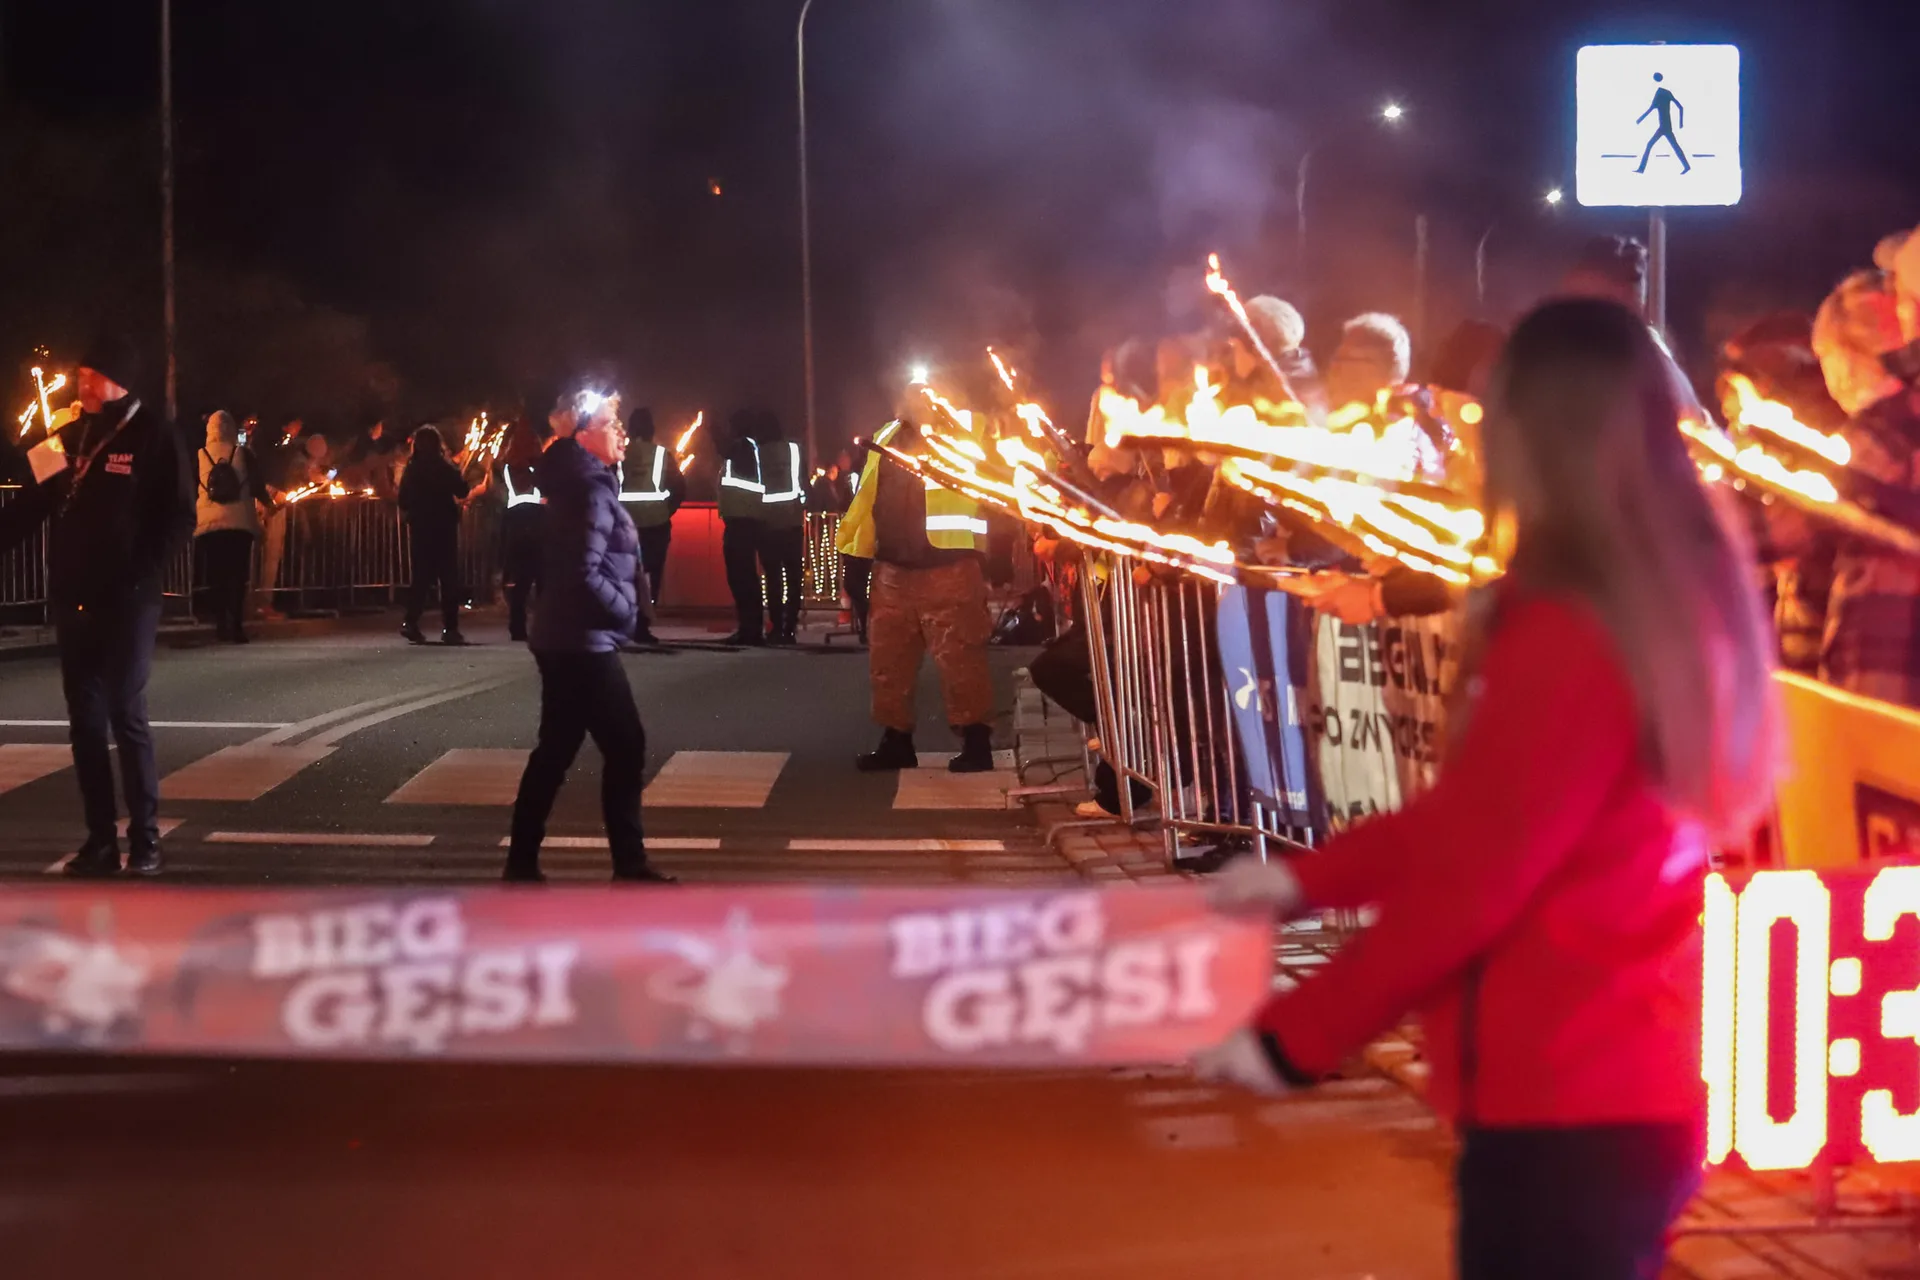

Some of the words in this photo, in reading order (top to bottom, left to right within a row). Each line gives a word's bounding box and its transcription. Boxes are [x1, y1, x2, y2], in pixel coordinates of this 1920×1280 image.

[253, 897, 463, 977] BIEG
[891, 895, 1104, 977] BIEG
[284, 942, 578, 1052] GĘSI
[924, 938, 1218, 1052] GĘSI
